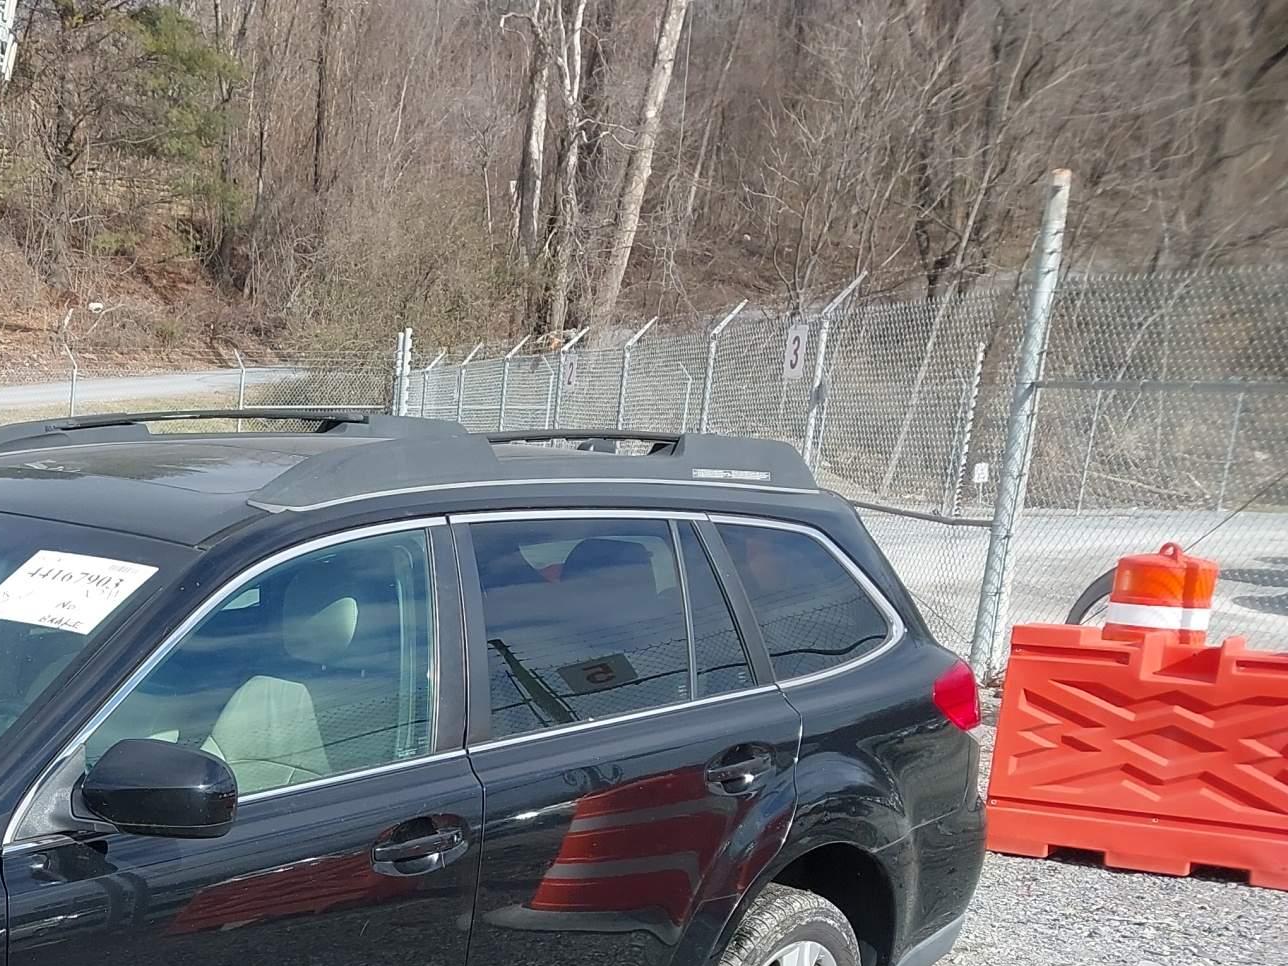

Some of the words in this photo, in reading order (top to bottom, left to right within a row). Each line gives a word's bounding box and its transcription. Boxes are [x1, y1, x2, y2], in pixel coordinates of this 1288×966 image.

[790, 335, 801, 369] 3
[567, 362, 574, 385] 2
[27, 566, 125, 588] 44167903
